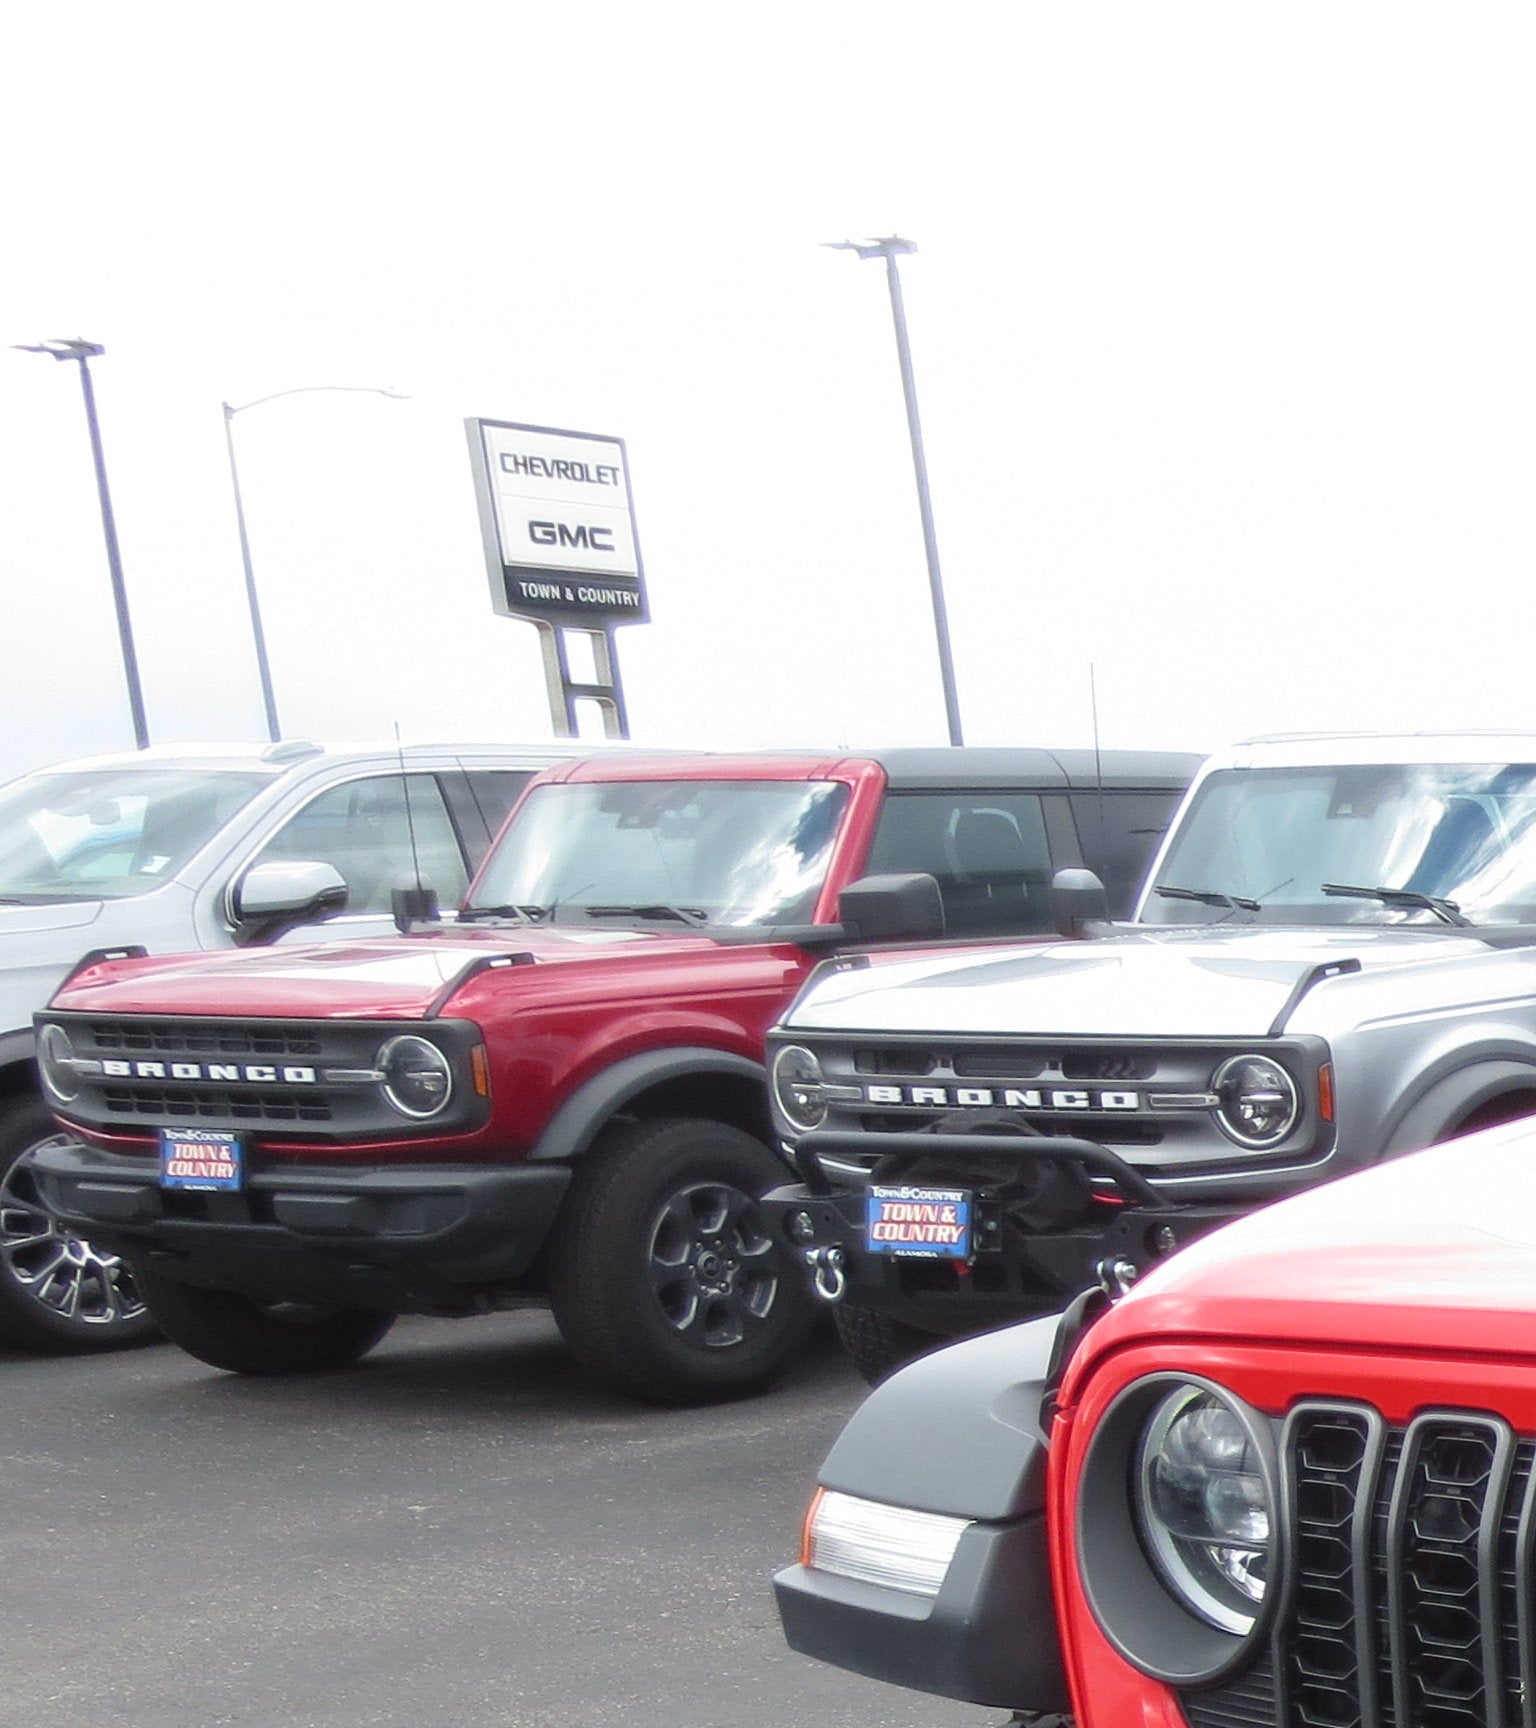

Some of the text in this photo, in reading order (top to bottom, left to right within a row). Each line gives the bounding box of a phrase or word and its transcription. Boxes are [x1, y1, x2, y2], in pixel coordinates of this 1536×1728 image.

[500, 452, 620, 487] CHEVROLET
[528, 520, 616, 552] GMC
[519, 581, 640, 607] TOWN & COUNTRY
[102, 1059, 316, 1083] BRONCO
[868, 1085, 1138, 1109] BRONCO
[173, 1143, 231, 1160] TOWN &
[167, 1160, 237, 1178] COUNTRY
[881, 1203, 957, 1223] TOWN &
[872, 1222, 965, 1243] COUNTRY
